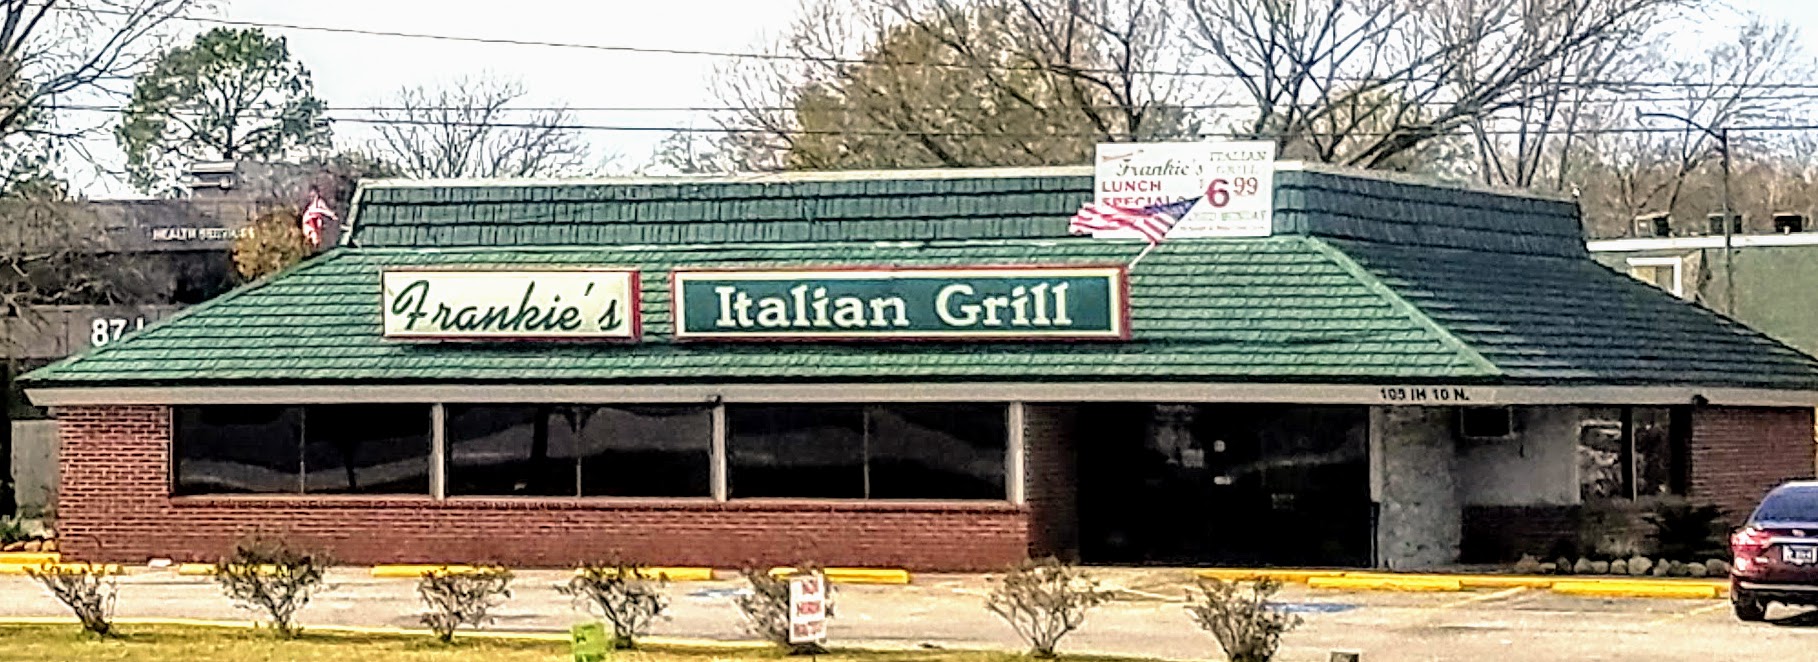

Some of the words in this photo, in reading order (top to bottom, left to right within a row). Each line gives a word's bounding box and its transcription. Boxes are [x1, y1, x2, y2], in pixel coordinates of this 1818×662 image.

[1116, 158, 1203, 177] Frankie's
[1101, 180, 1162, 192] LUNCH
[152, 227, 198, 241] HEALTH
[391, 279, 623, 331] Frankie's
[714, 284, 910, 328] Italian
[935, 281, 1074, 327] Grill
[1411, 387, 1427, 401] IH
[1433, 388, 1449, 401] 10
[1454, 387, 1470, 401] N.
